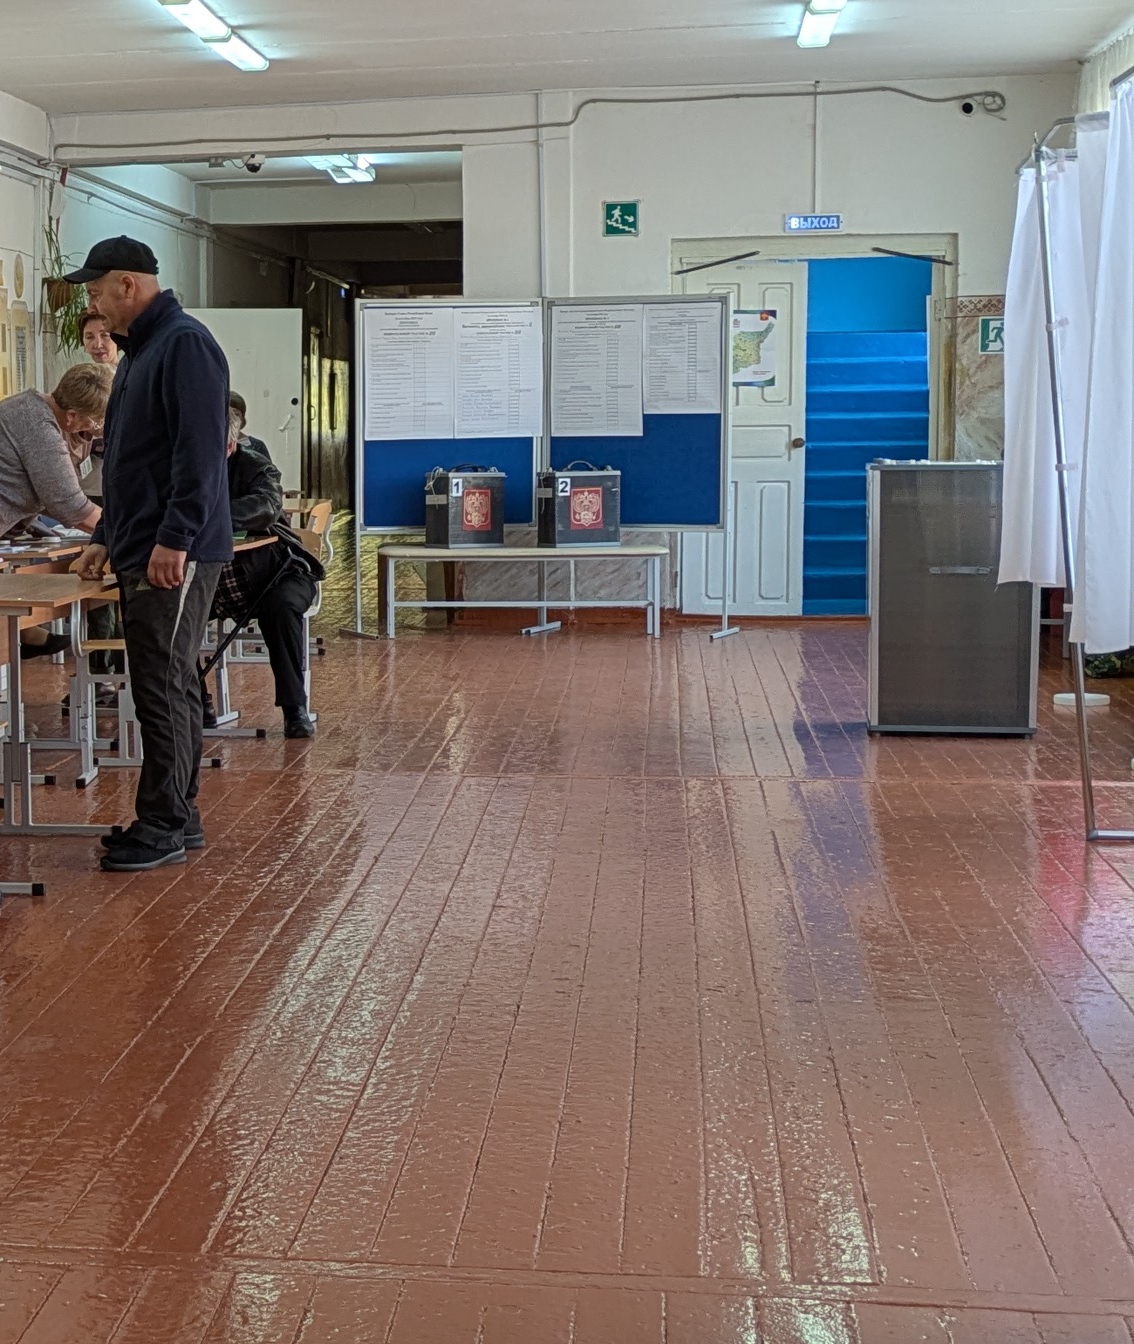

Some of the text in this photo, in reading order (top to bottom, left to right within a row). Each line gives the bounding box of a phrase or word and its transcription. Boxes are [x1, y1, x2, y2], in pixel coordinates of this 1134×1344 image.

[790, 217, 839, 230] ВЫХОД
[453, 481, 460, 494] 1
[559, 480, 569, 494] 2
